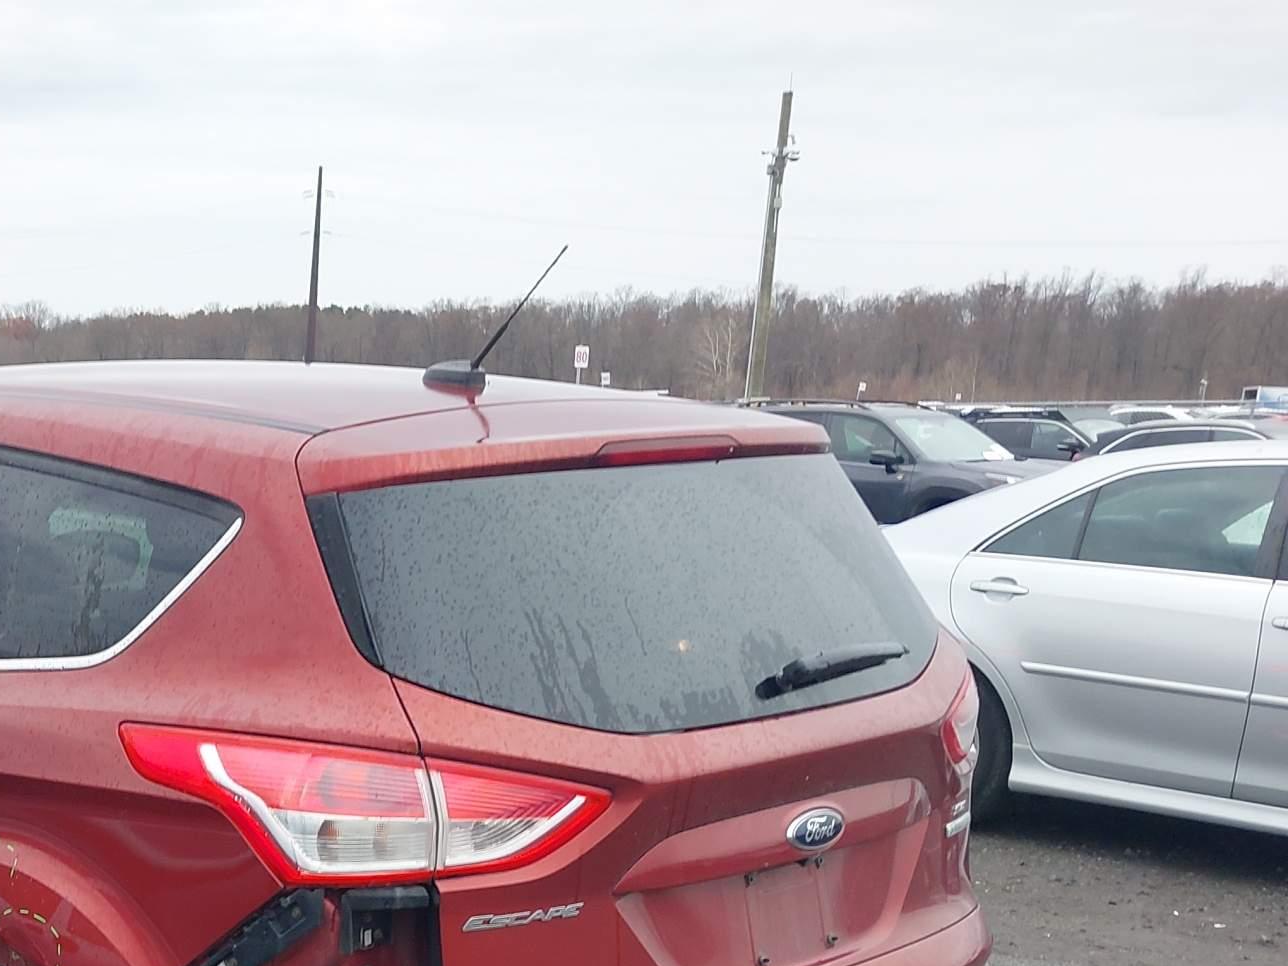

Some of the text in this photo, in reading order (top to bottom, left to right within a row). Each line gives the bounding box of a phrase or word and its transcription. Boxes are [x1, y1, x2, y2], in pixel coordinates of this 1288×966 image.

[576, 351, 588, 363] 80
[805, 815, 836, 843] Ford
[461, 901, 585, 932] ESCAPE
